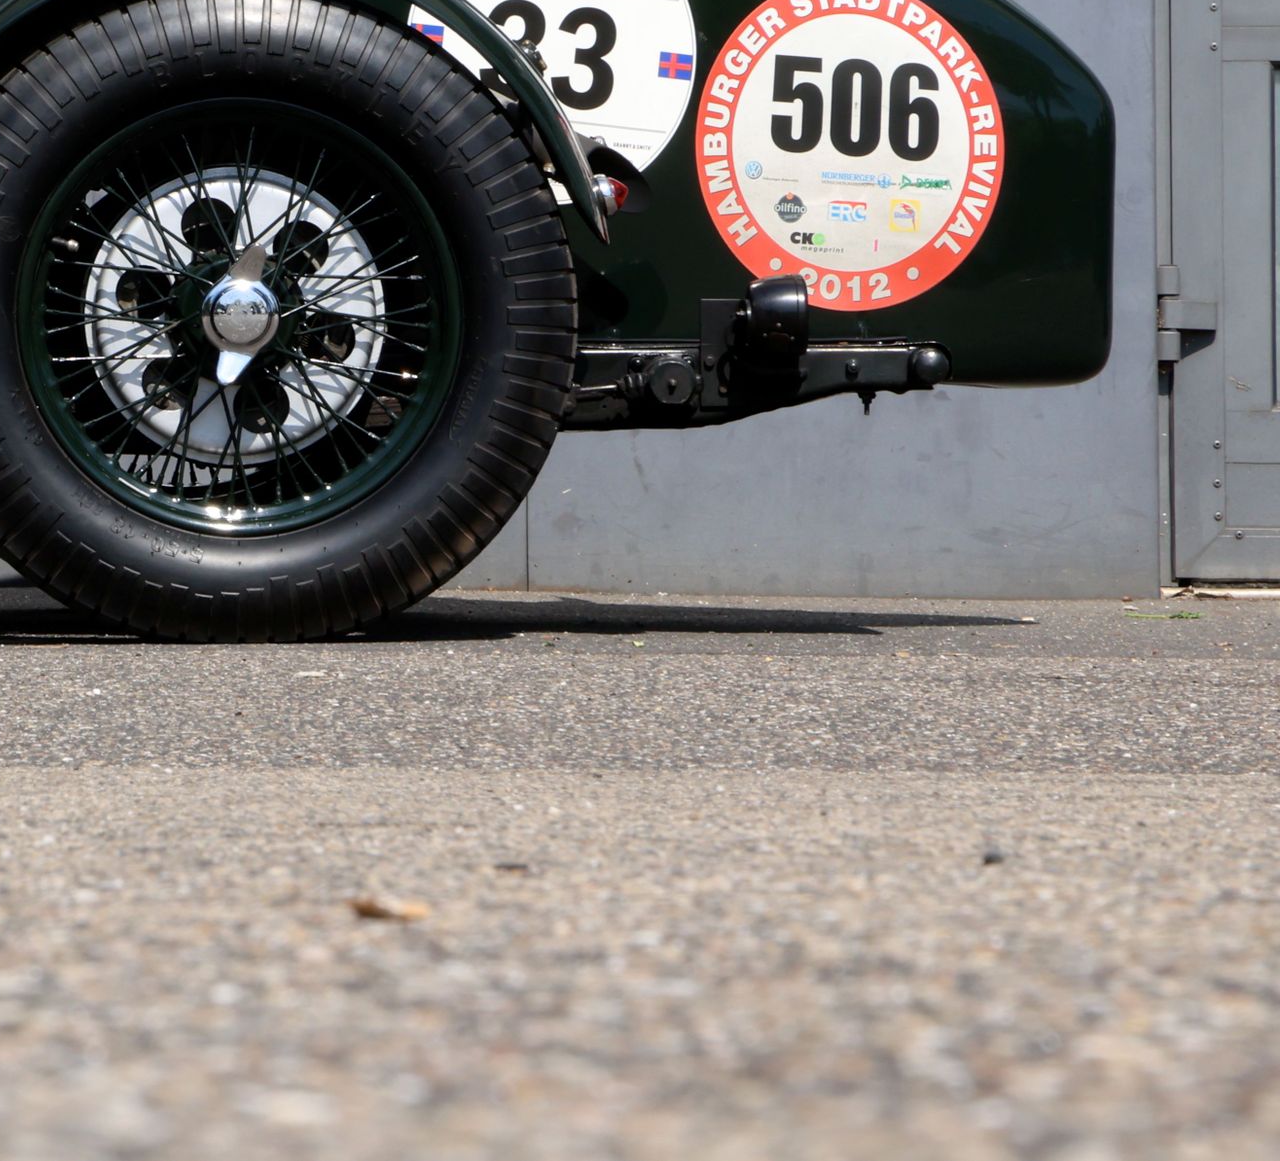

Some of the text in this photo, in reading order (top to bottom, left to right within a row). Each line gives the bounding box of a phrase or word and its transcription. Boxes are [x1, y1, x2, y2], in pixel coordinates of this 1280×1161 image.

[770, 54, 940, 162] 506
[703, 6, 787, 246] HAMBURGER
[773, 201, 808, 215] oilfino
[800, 245, 845, 254] megaprint
[798, 267, 891, 302] 2012
